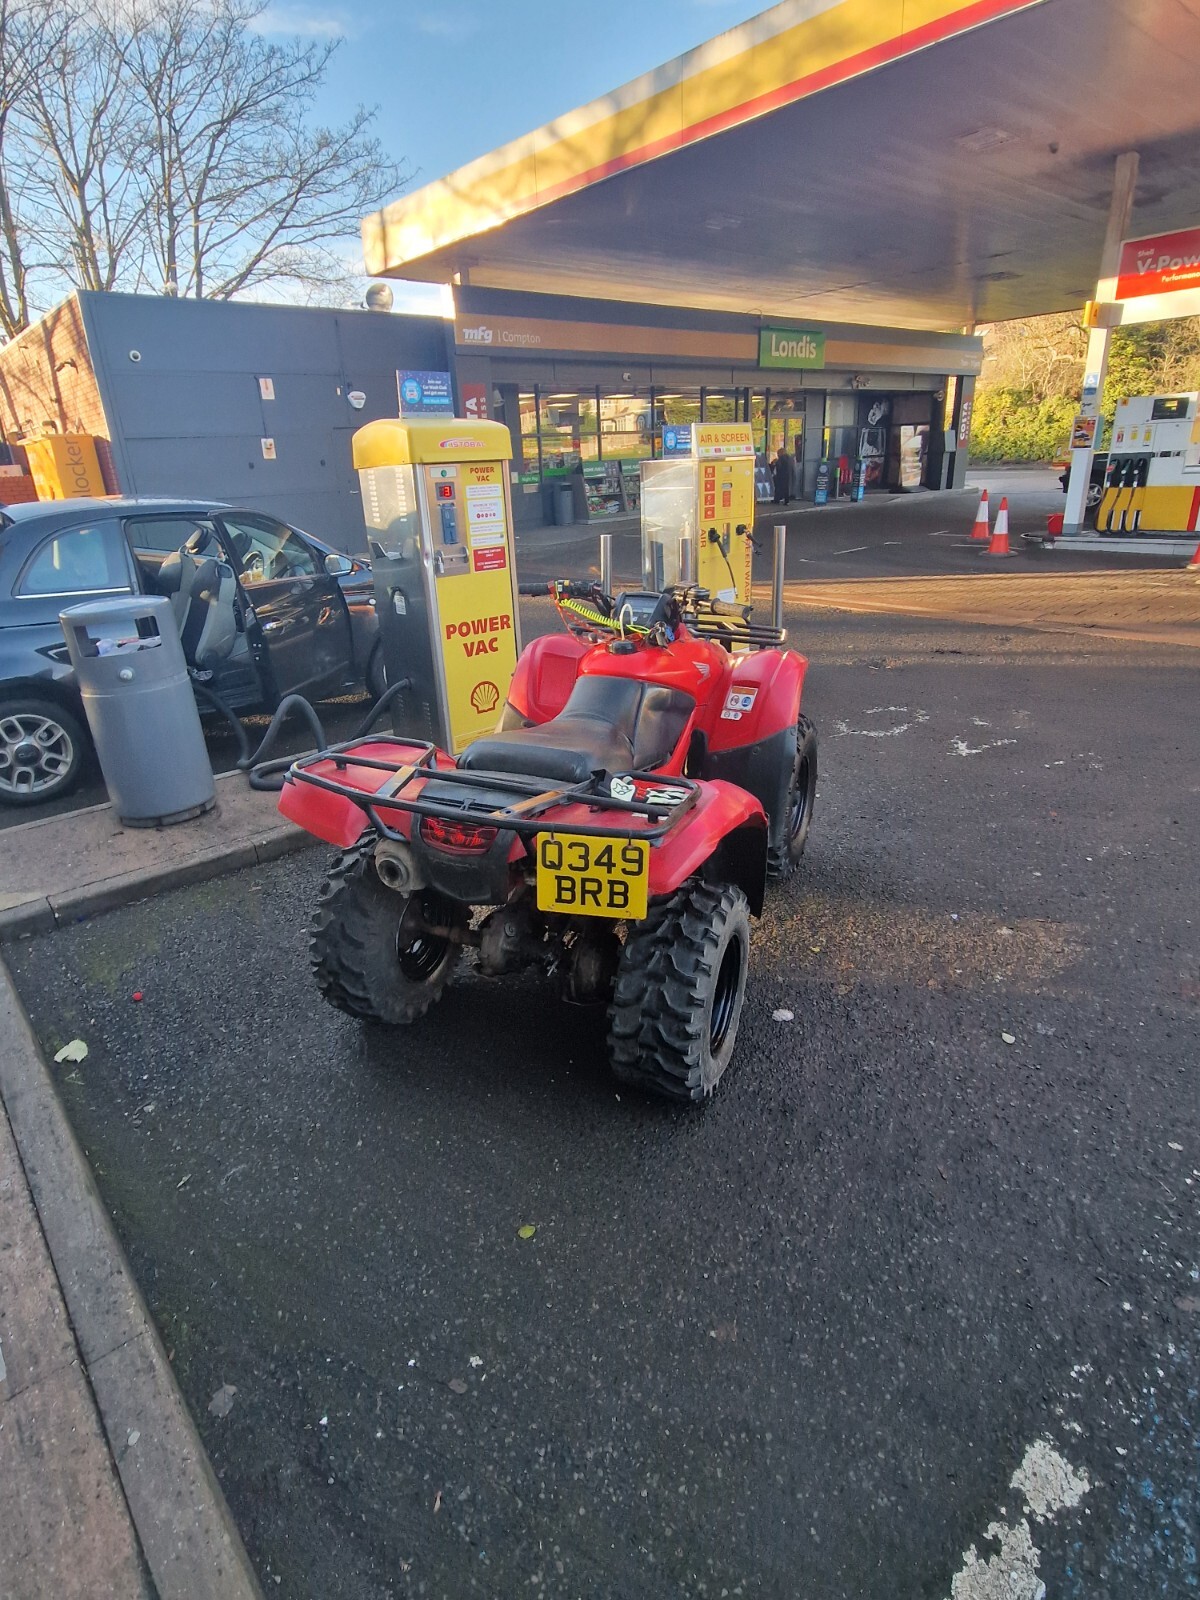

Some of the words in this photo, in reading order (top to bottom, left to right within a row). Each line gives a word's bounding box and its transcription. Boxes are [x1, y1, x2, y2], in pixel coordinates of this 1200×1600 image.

[1137, 248, 1155, 258] Shell
[1136, 255, 1200, 276] V-Pow
[463, 326, 493, 344] mfg
[502, 331, 541, 345] Compton
[771, 333, 817, 359] Londis
[959, 401, 969, 440] COSTA
[700, 433, 713, 443] AIR
[714, 433, 720, 443] &
[720, 432, 750, 443] SCREEN
[65, 437, 92, 494] locker
[469, 466, 495, 474] POWER
[443, 486, 451, 497] 3
[744, 523, 752, 568] SREEN
[445, 614, 511, 640] POWER
[463, 637, 499, 658] VAC
[541, 839, 644, 876] Q349
[554, 874, 629, 909] BRB
